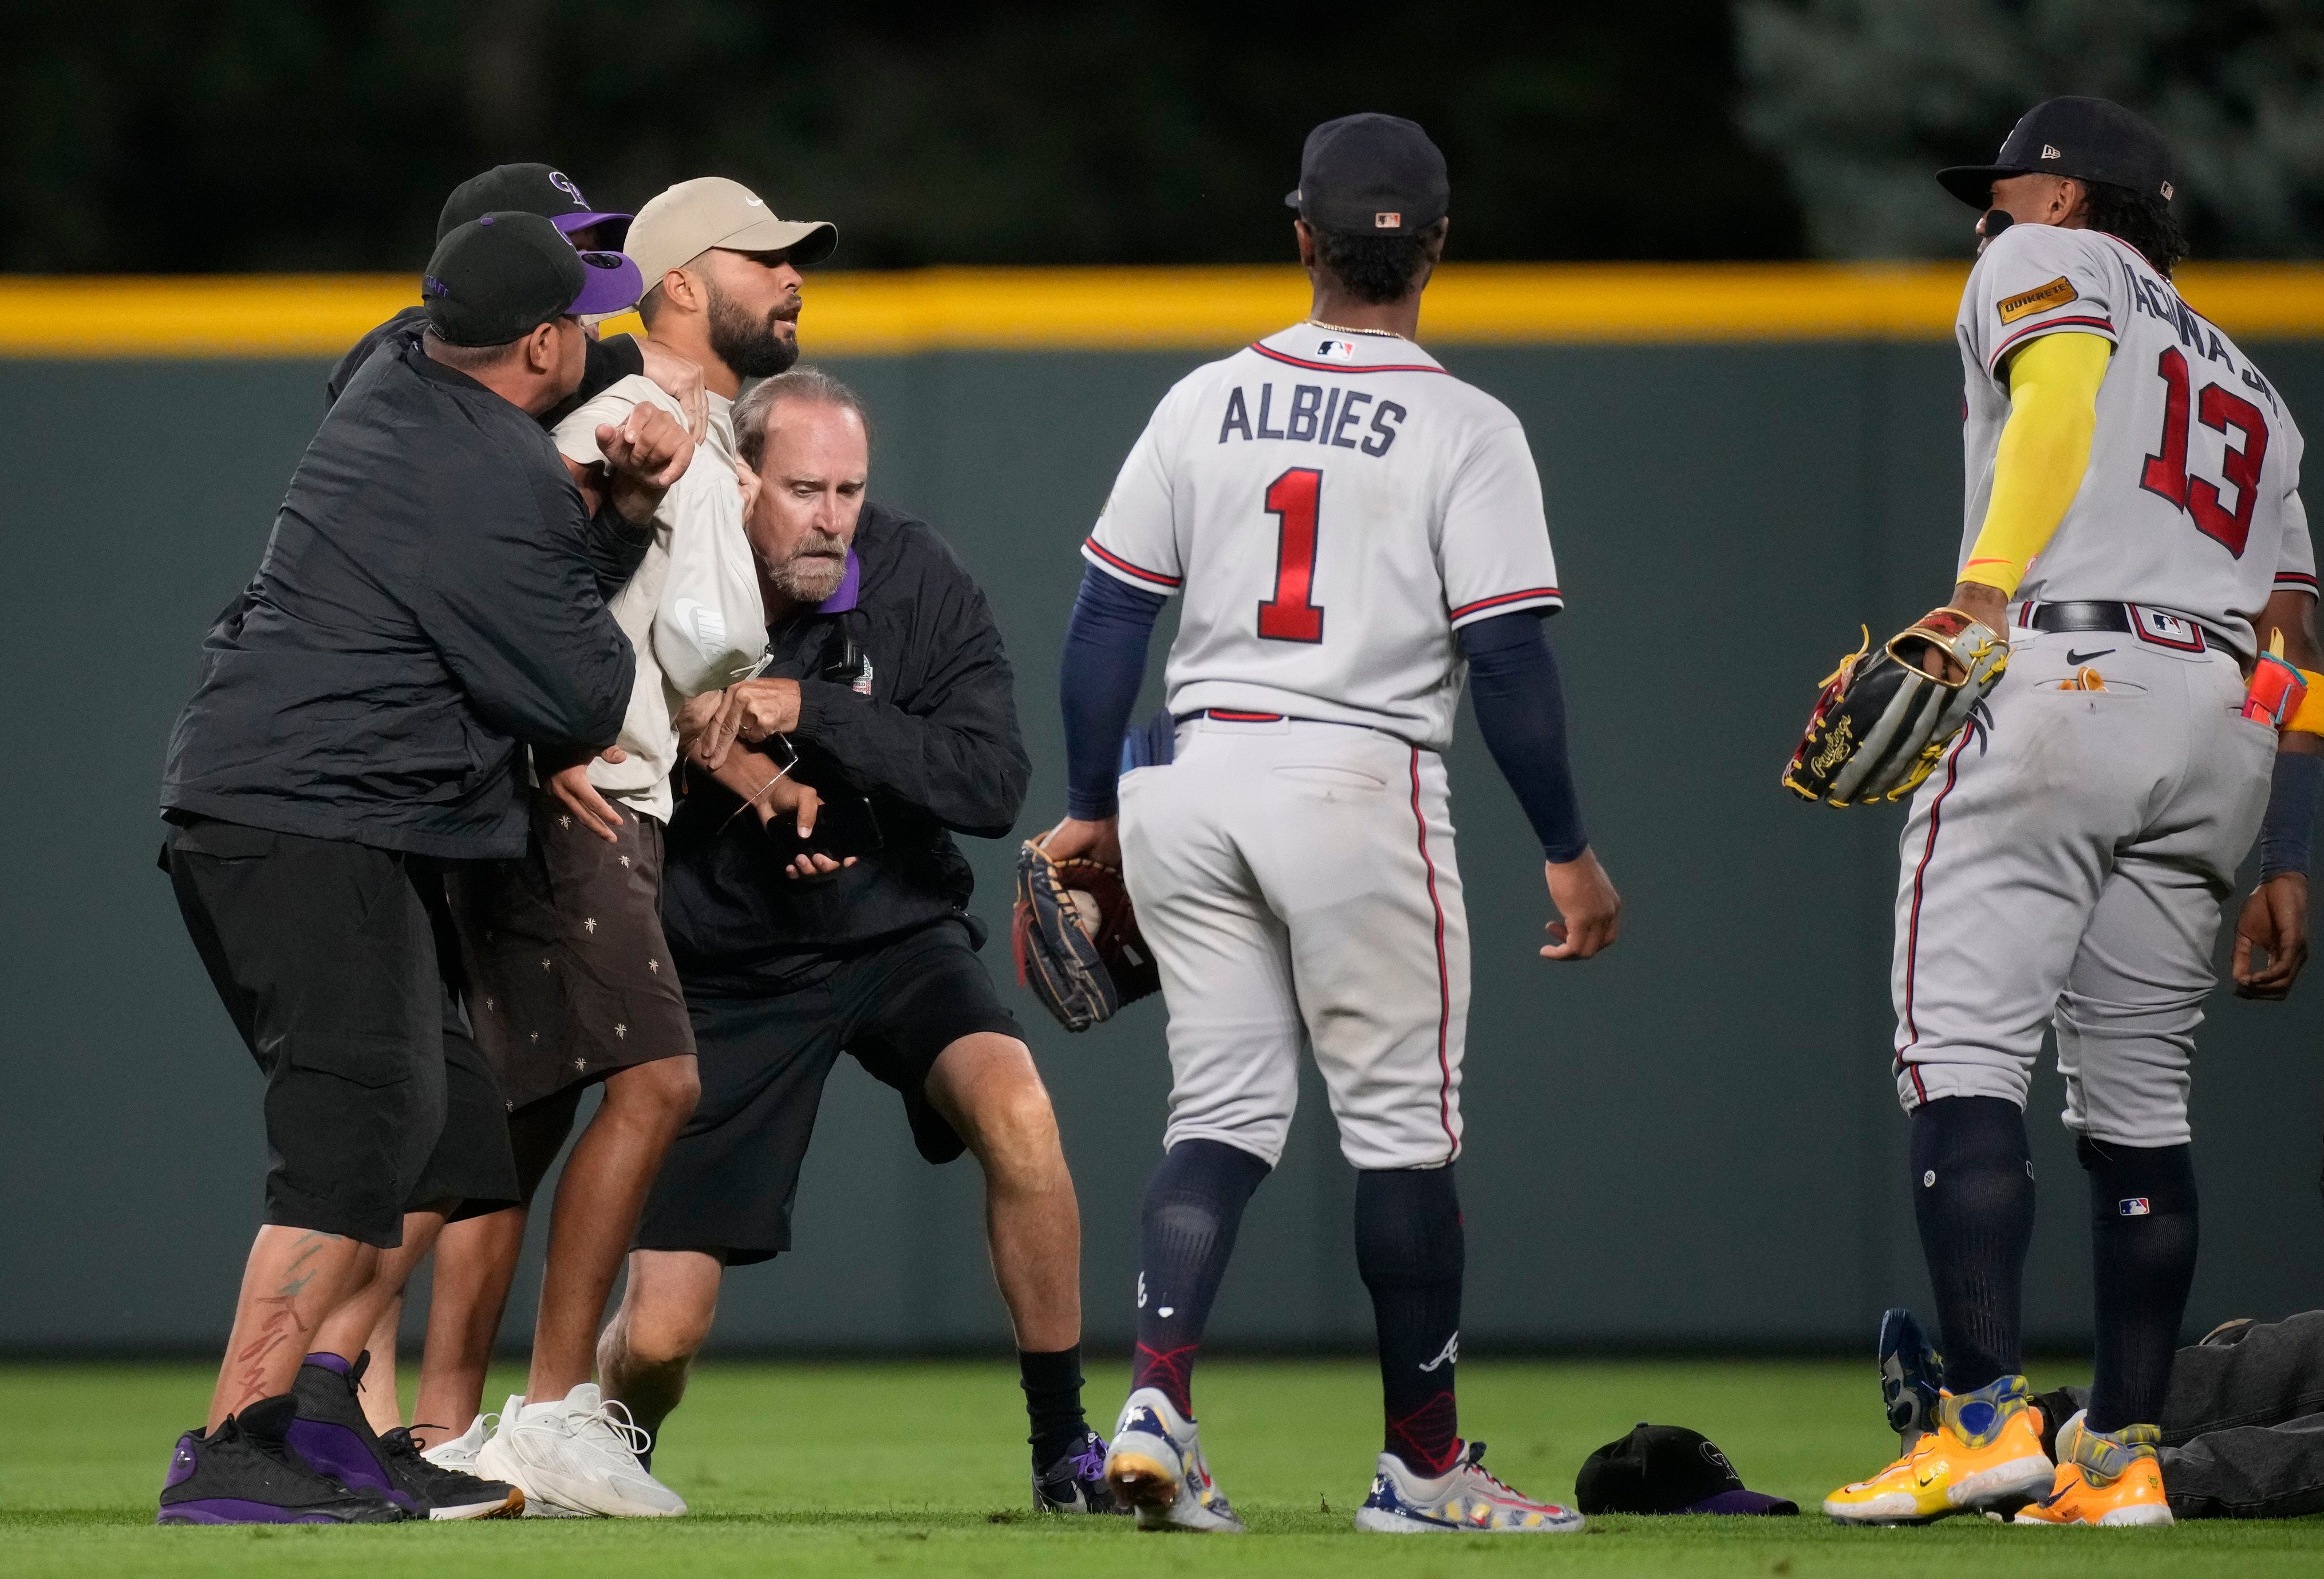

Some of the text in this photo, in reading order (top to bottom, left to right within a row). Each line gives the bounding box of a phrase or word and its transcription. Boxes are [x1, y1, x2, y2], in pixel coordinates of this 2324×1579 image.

[2005, 283, 2066, 313] QUIKRETE
[1218, 383, 1407, 458] ALBIES
[2139, 345, 2269, 561] 13
[1257, 466, 1324, 645] 1
[696, 608, 727, 656] NIKE
[1811, 714, 1853, 778] Rawlings
